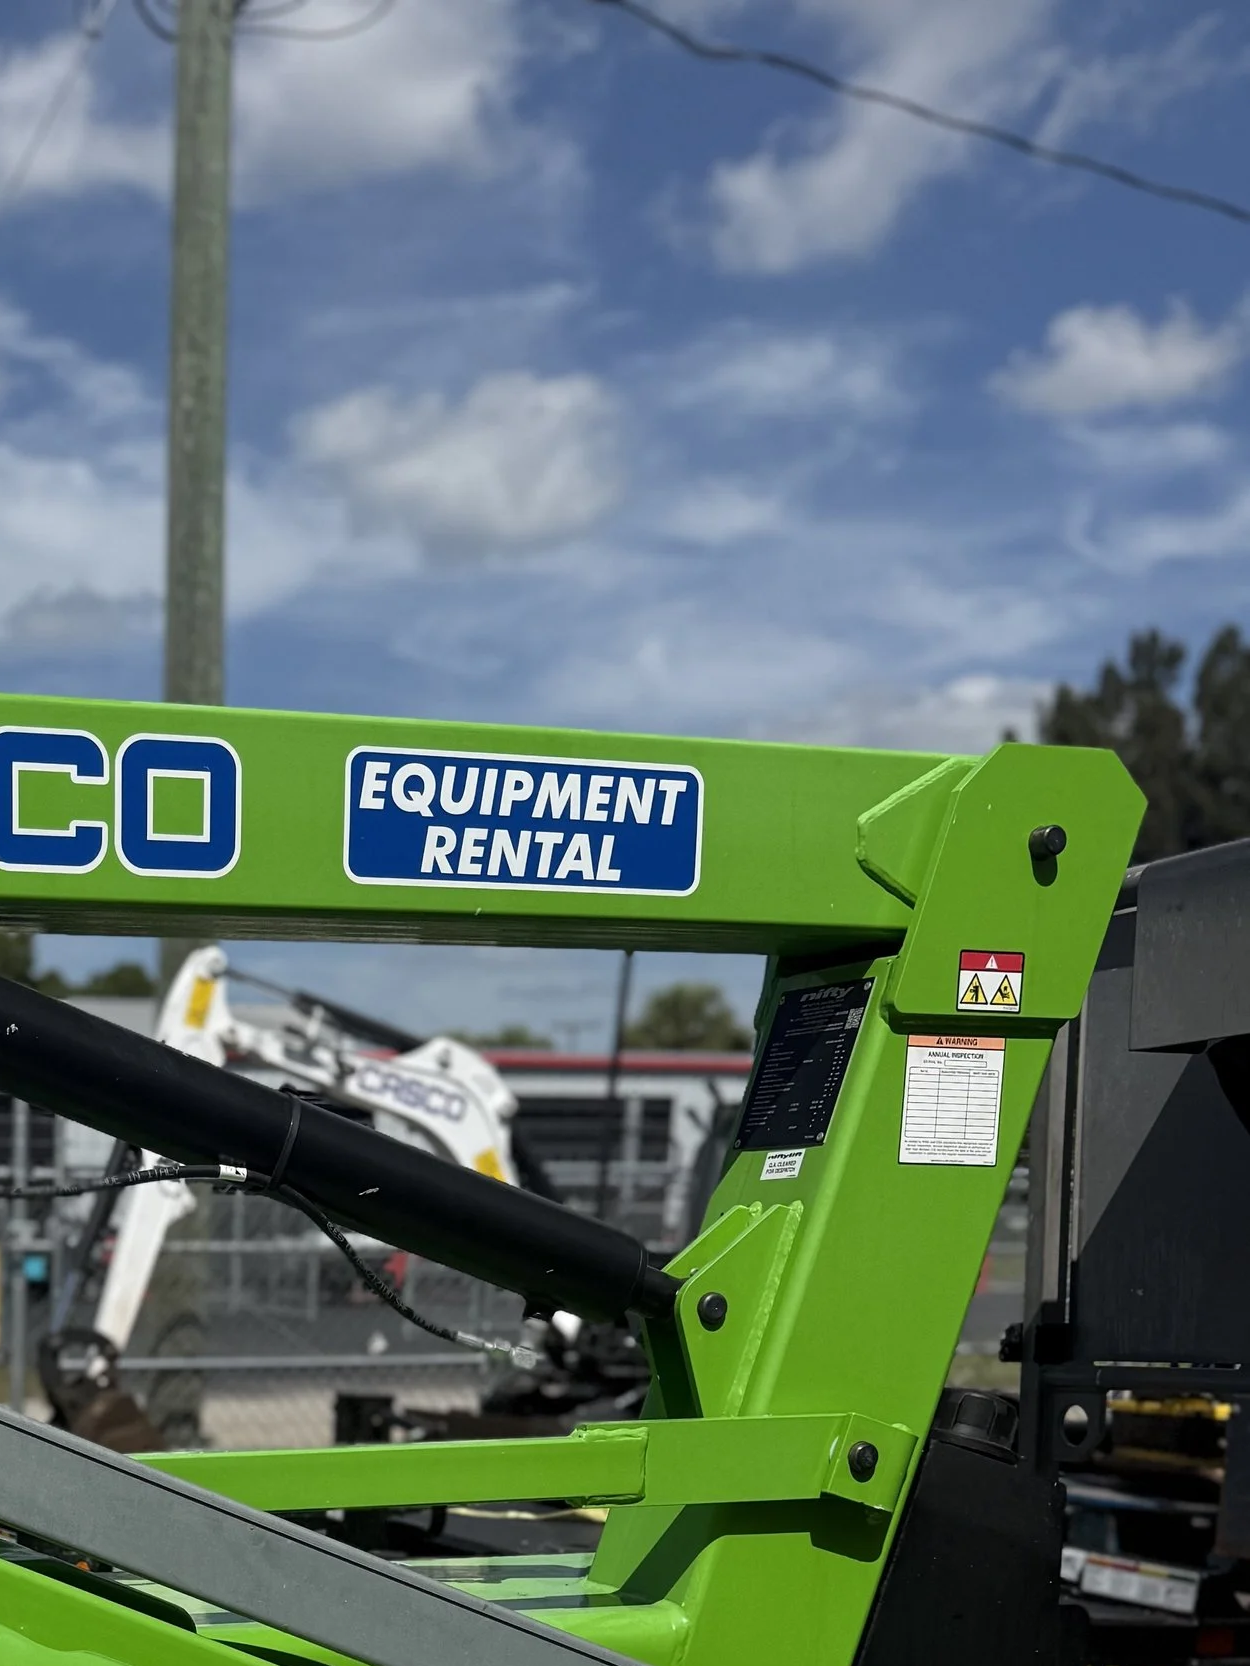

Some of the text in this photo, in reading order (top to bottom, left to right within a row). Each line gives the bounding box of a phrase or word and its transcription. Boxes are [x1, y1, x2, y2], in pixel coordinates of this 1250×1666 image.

[359, 760, 687, 825] EQUIPMENT
[420, 825, 621, 882] RENTAL
[945, 1037, 978, 1046] WARNING
[356, 1062, 468, 1125] CASCO
